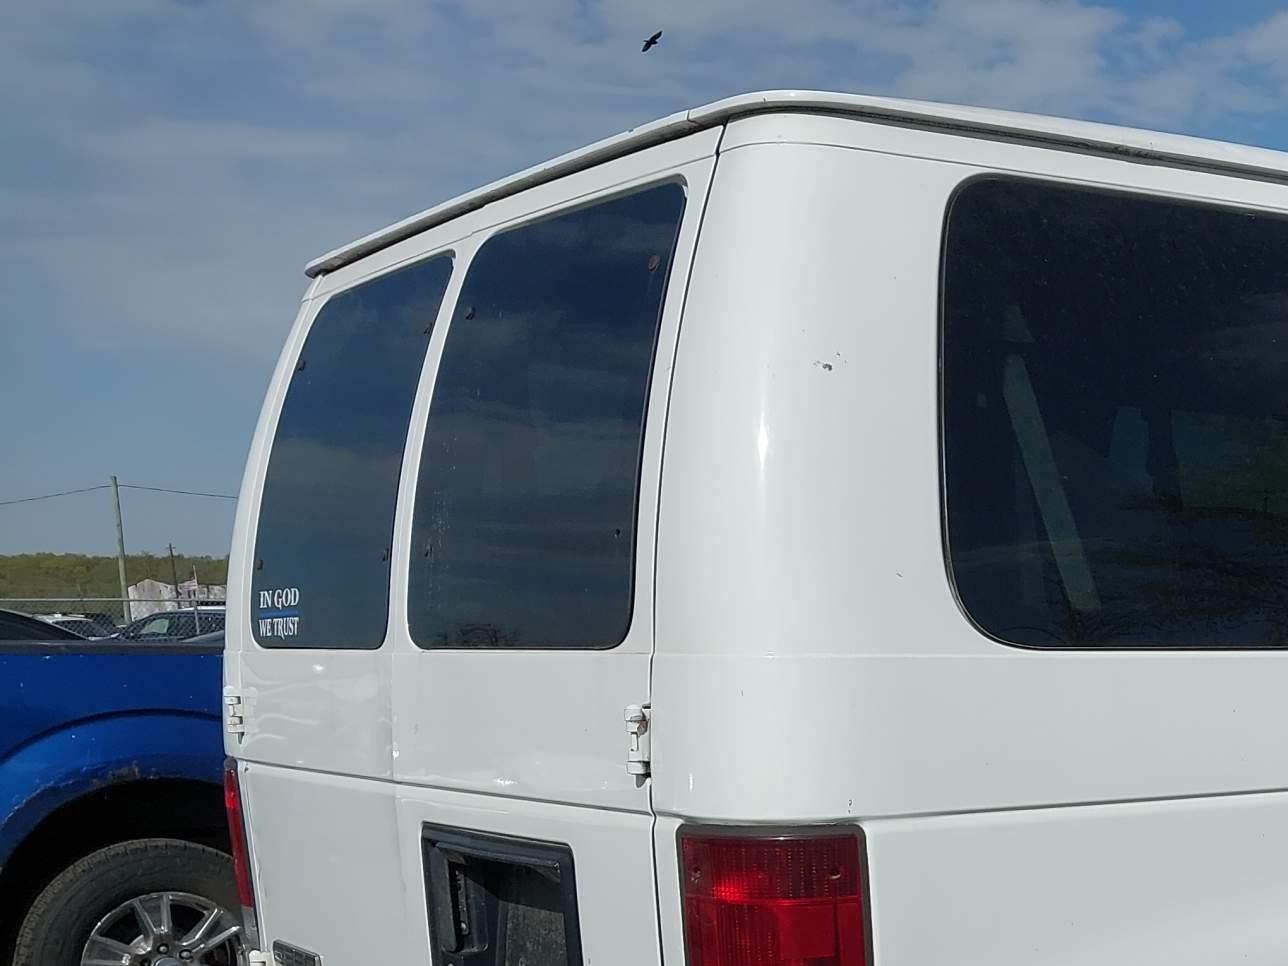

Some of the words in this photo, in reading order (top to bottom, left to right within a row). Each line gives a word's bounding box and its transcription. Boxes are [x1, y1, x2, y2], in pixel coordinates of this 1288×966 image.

[259, 591, 273, 609] IN
[274, 588, 299, 610] GOD
[258, 618, 272, 637] WE
[273, 617, 299, 639] TRUST
